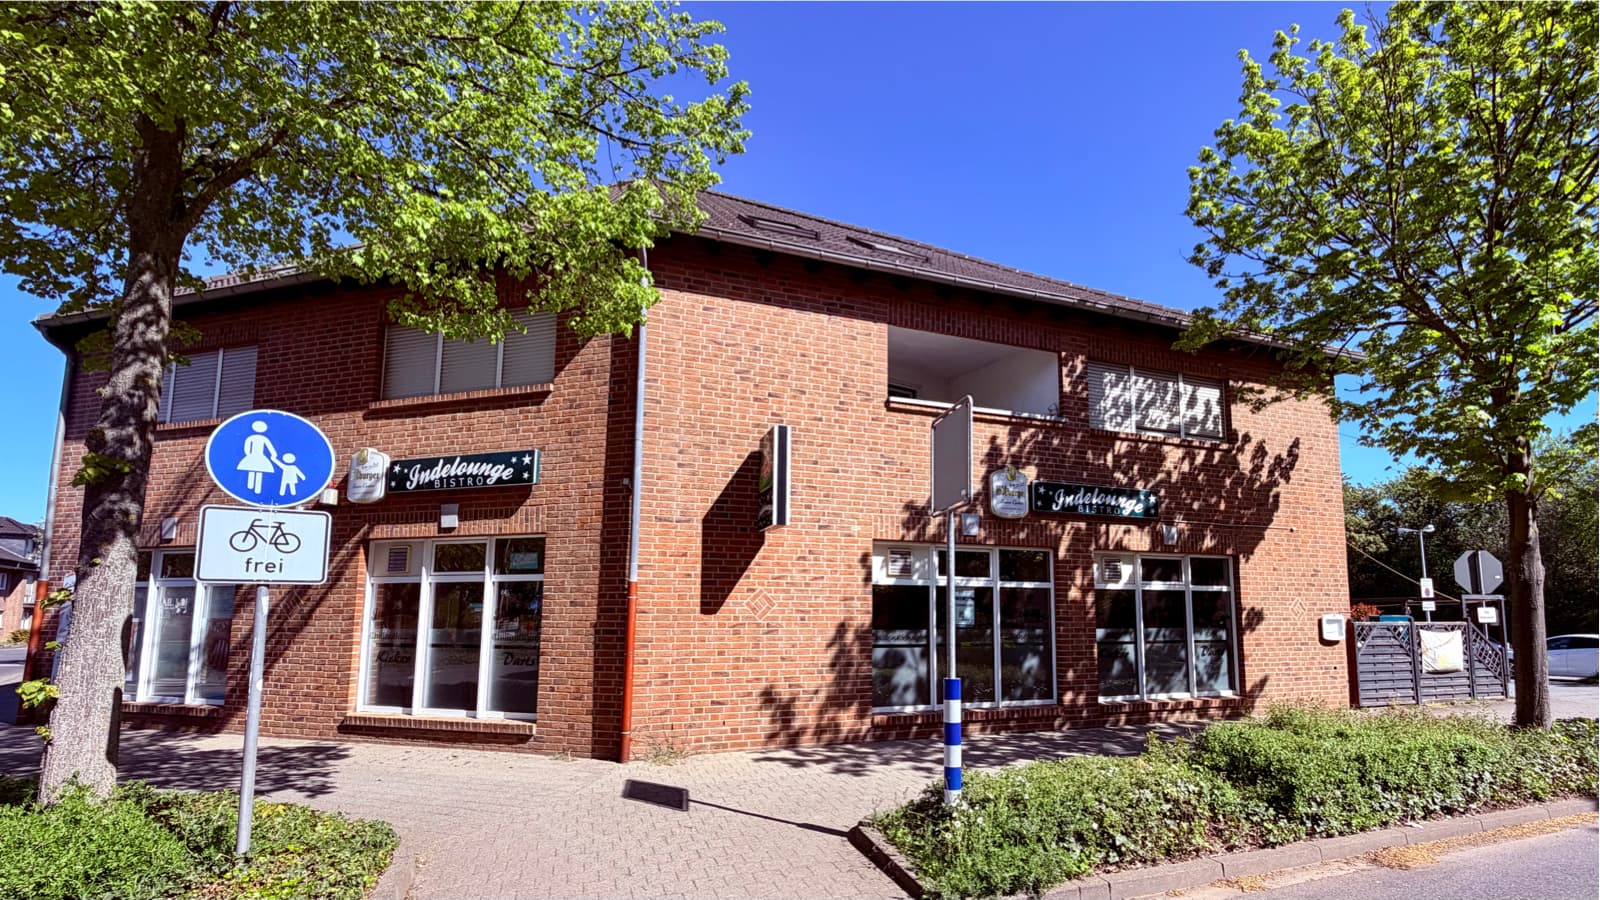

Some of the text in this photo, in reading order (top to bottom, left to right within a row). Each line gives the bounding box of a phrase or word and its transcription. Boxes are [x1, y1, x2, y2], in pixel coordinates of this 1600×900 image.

[405, 456, 514, 490] Indelounge
[434, 477, 484, 489] BISTRO
[1052, 488, 1144, 515] Indelounge
[1078, 504, 1121, 515] BISTRO
[245, 557, 283, 573] frei
